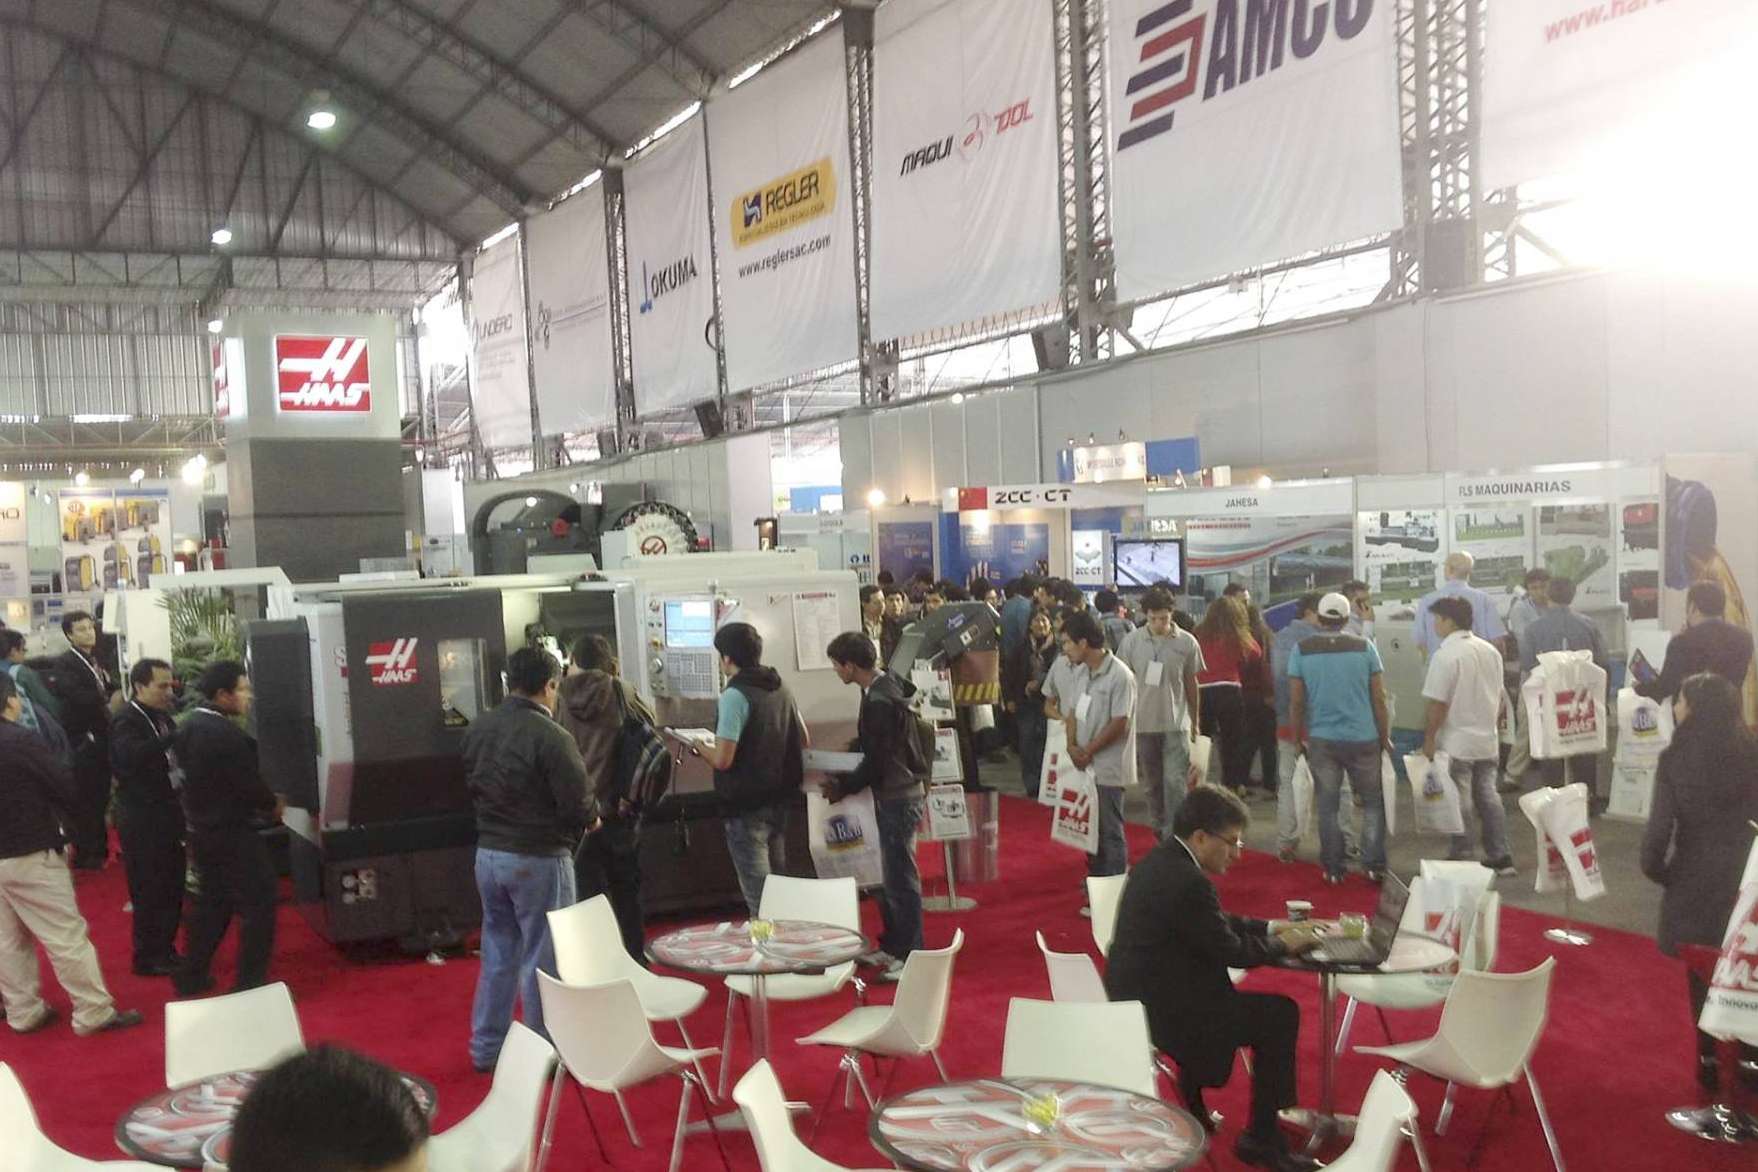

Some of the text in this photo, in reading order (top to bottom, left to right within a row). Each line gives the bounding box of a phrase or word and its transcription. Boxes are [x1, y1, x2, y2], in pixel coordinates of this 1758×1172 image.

[1544, 0, 1669, 42] www.ha
[900, 135, 954, 176] MAQUI
[766, 170, 820, 216] REGLER
[651, 253, 698, 298] OKUMA
[738, 234, 832, 278] www.reglersac.com
[280, 382, 370, 406] HAAS
[1045, 489, 1071, 502] CT
[1475, 480, 1571, 496] MAQUINARIAS
[371, 668, 417, 684] HAAS
